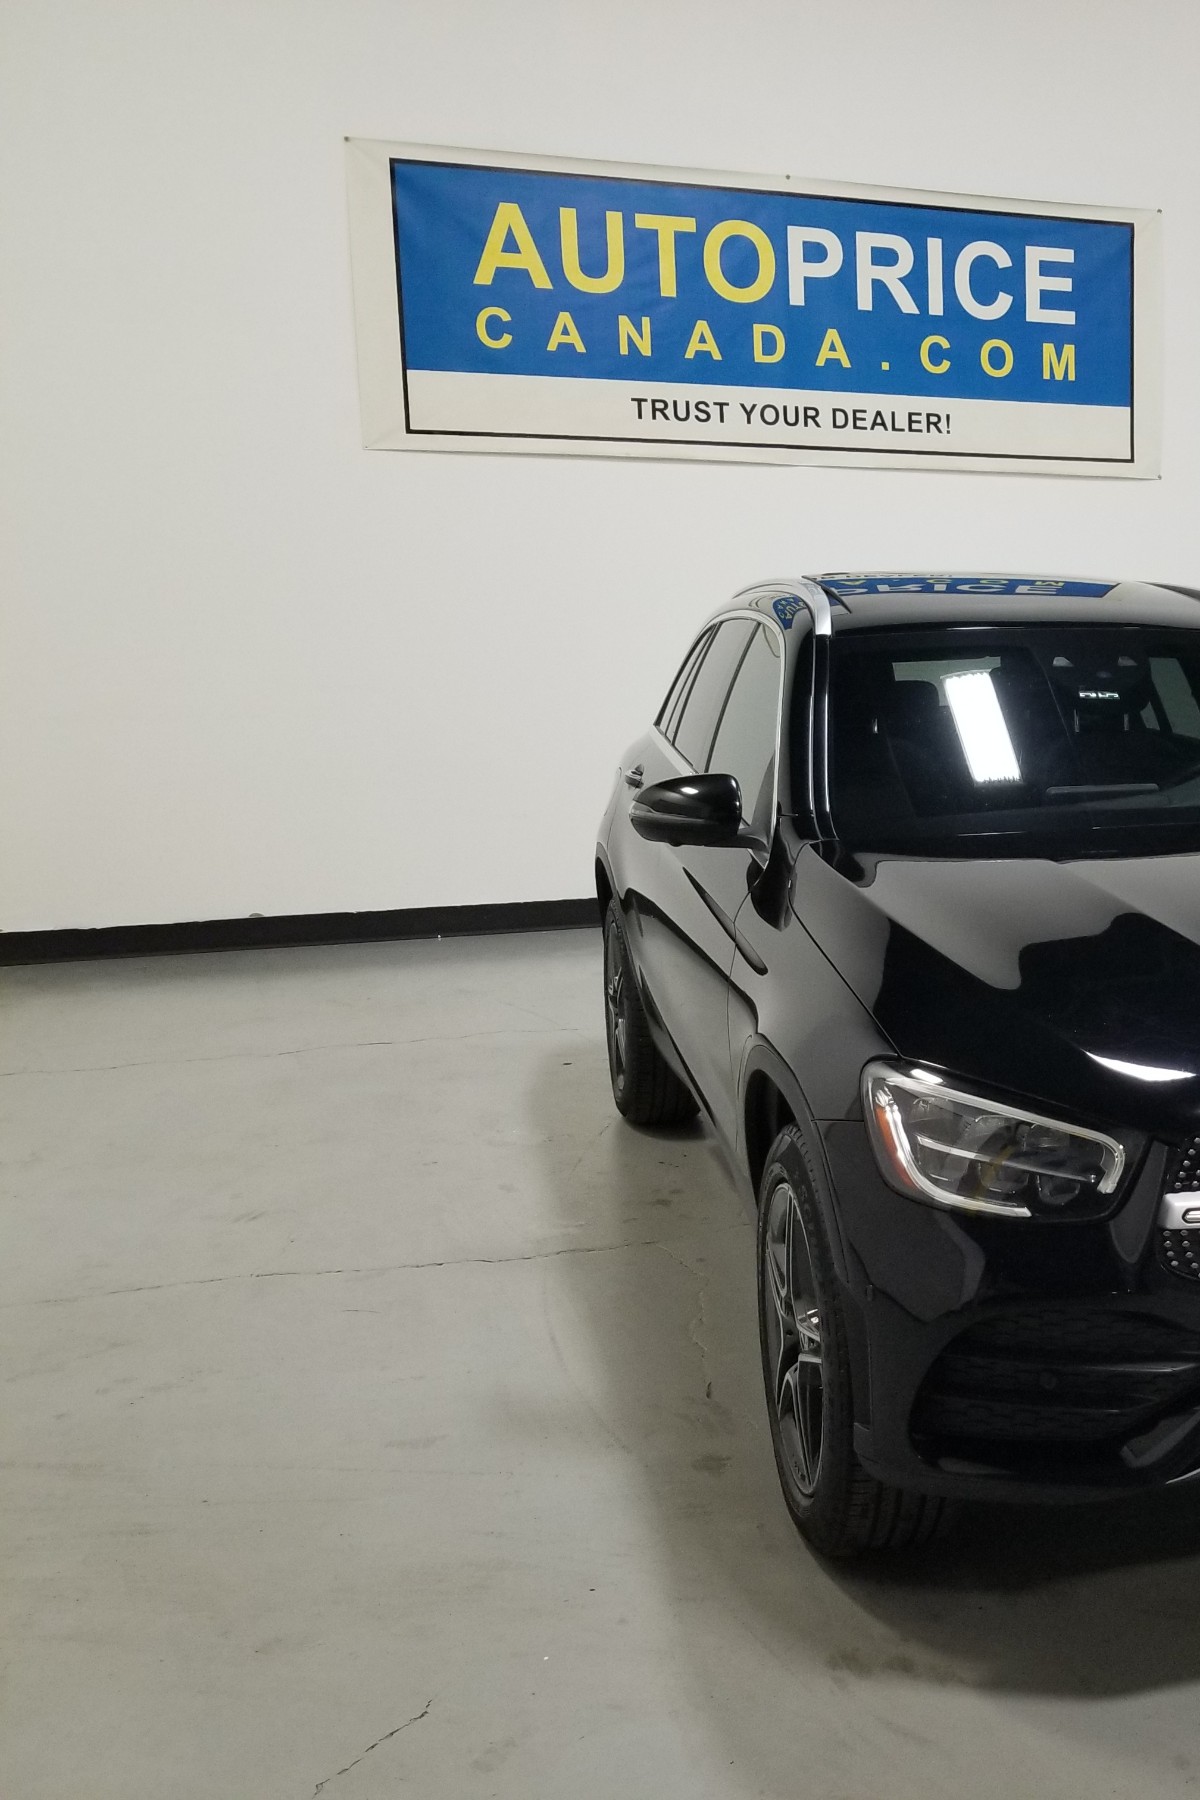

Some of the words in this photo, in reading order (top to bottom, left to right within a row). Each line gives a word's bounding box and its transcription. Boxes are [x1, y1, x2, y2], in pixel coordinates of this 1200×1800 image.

[473, 201, 1076, 325] AUTOPRICE
[475, 306, 1077, 381] CANADA.COM
[630, 397, 730, 424] TRUST
[739, 403, 821, 428] YOUR
[831, 407, 952, 434] DEALER!
